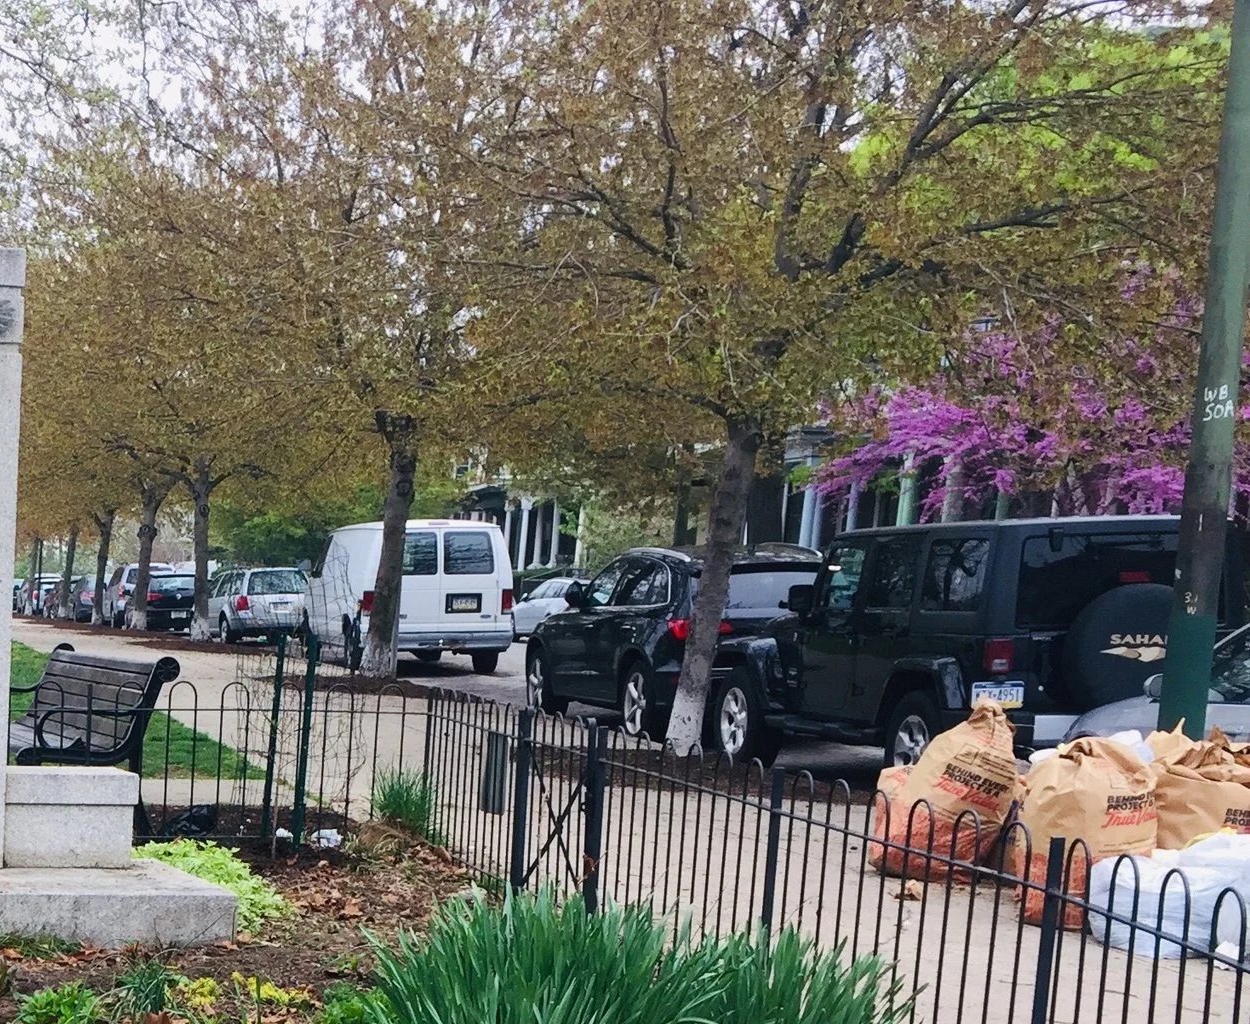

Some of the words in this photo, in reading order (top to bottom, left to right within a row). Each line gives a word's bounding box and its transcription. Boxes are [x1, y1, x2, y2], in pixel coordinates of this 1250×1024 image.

[1204, 384, 1229, 402] WB
[1110, 633, 1168, 645] SAHA
[942, 769, 984, 791] PROJECT
[945, 763, 982, 782] BEHIND
[1106, 800, 1149, 812] PROJECT
